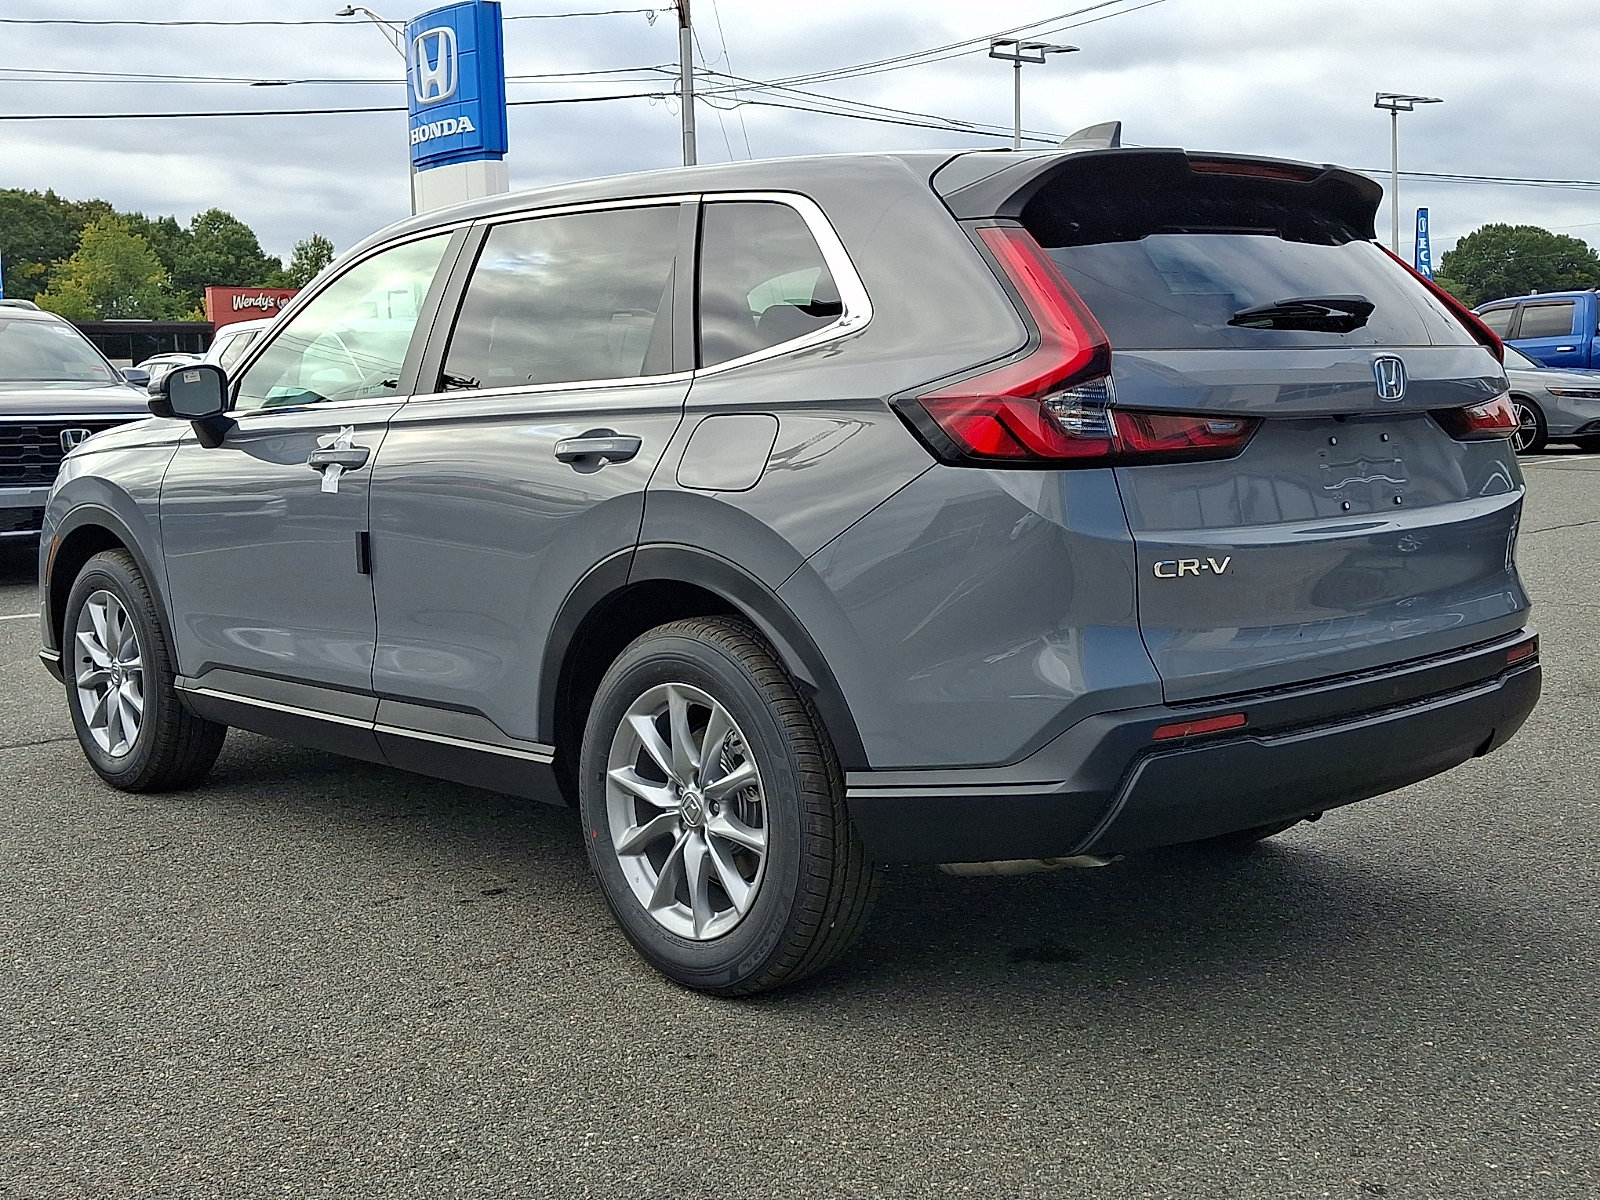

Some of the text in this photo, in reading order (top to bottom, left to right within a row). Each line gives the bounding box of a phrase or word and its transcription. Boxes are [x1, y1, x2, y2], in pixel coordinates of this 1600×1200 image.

[410, 116, 475, 146] HONDA
[232, 293, 275, 311] Wendy's
[1153, 556, 1231, 578] CR-V
